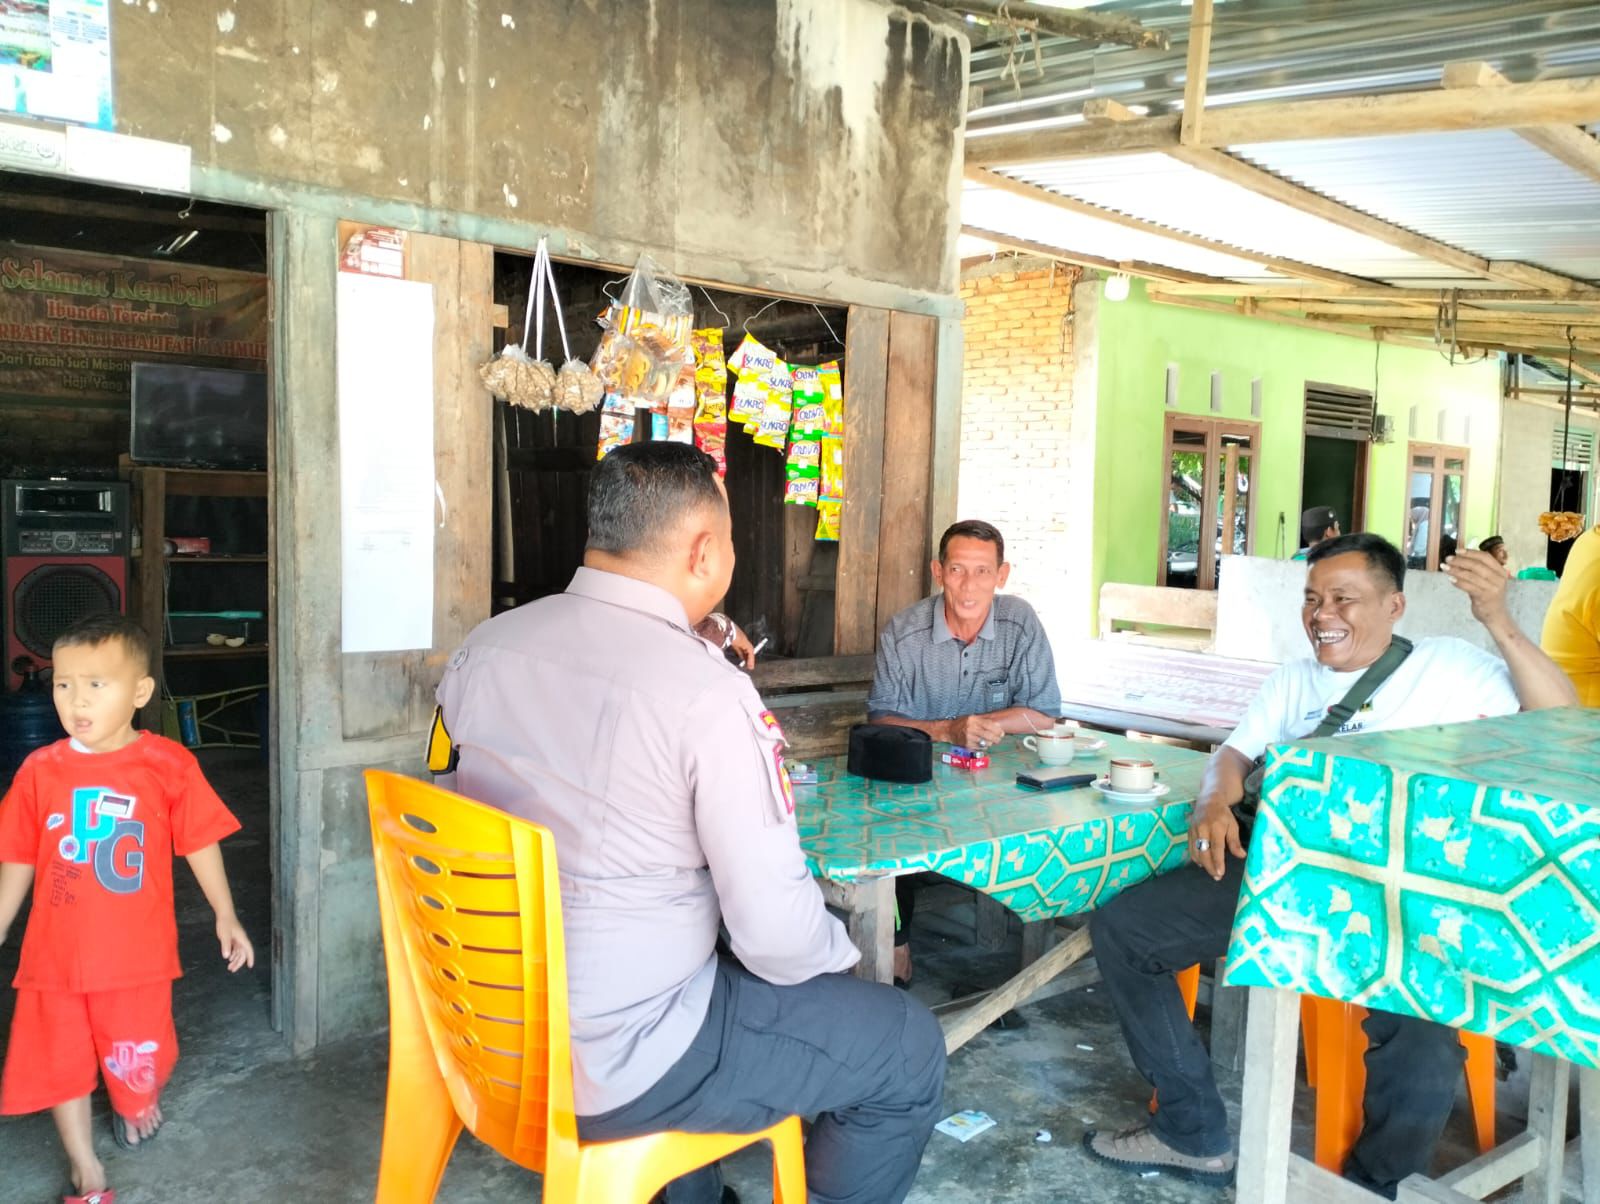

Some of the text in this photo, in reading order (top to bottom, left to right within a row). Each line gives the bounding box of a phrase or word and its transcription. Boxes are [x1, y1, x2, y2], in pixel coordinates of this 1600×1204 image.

[1, 257, 218, 308] Selamat Kembali
[46, 299, 109, 323] Ibunda
[26, 353, 65, 368] Tanah
[67, 357, 89, 369] Suci
[63, 376, 87, 390] Haji
